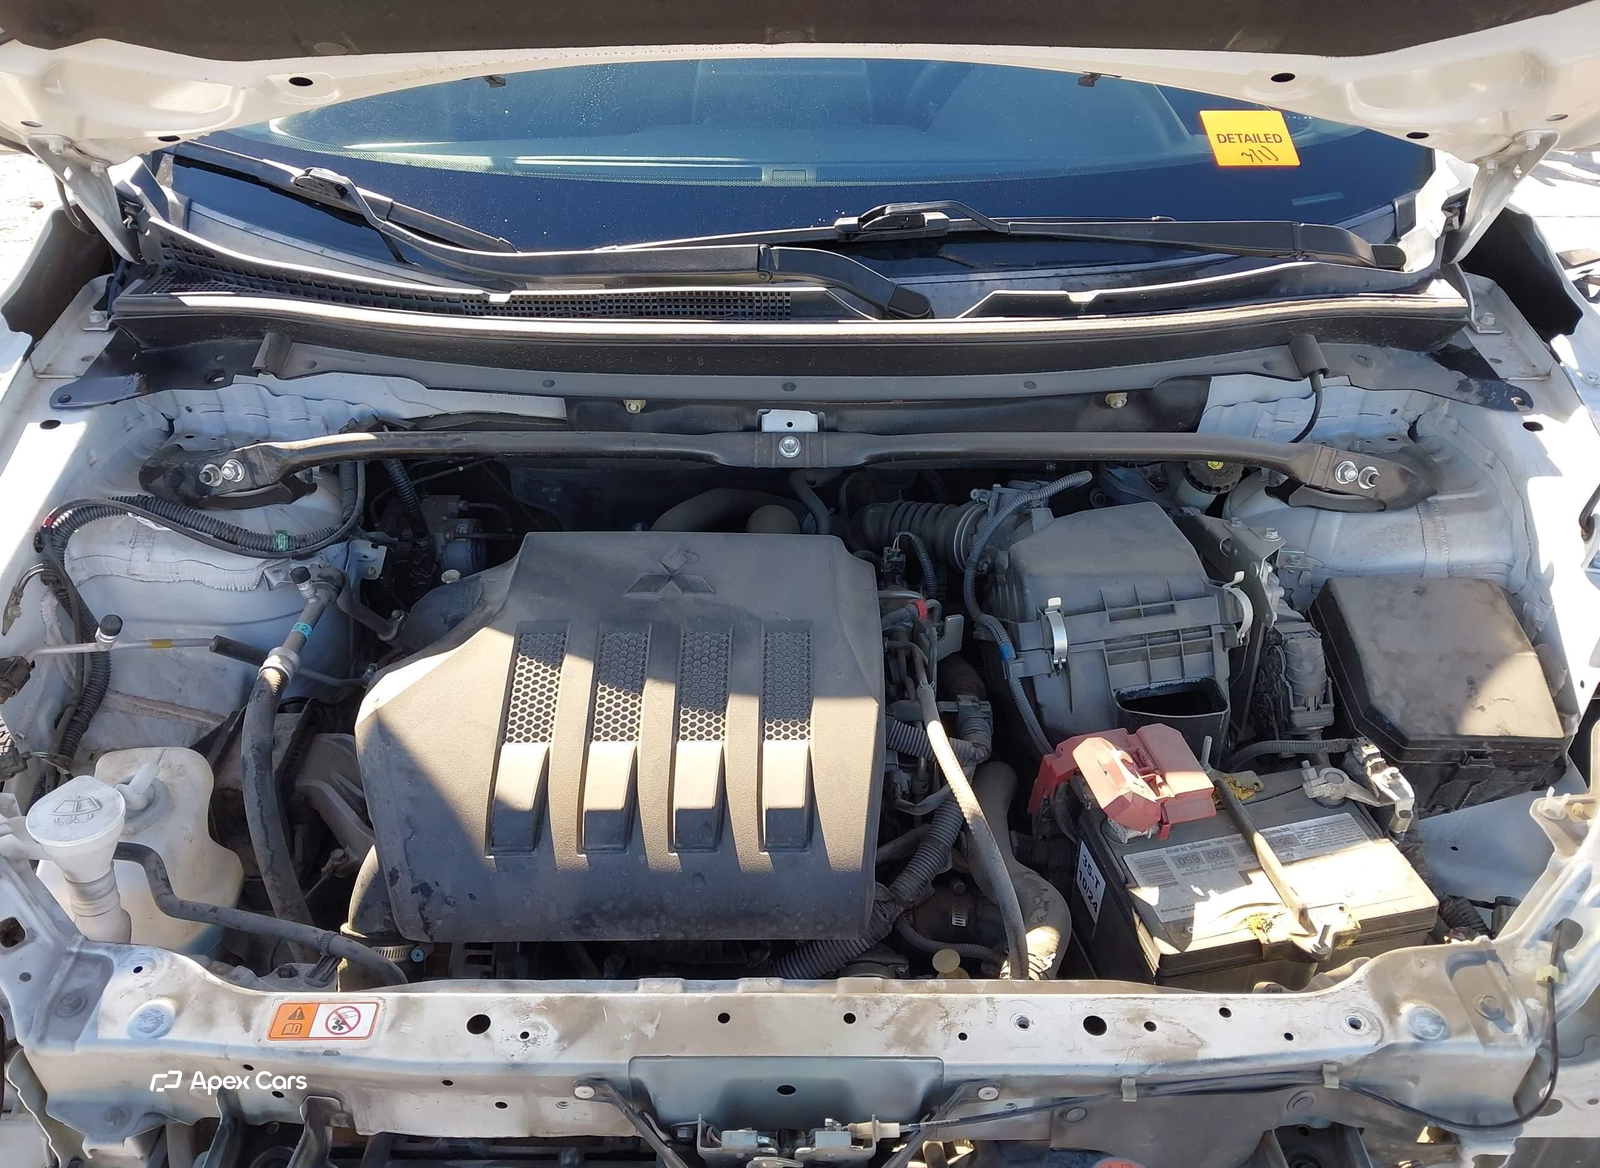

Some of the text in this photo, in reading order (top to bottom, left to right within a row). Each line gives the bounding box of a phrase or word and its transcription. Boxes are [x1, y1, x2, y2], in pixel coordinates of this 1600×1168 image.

[1216, 133, 1283, 144] DETAILED
[1178, 854, 1201, 867] 650
[1207, 848, 1230, 861] 520
[1082, 855, 1101, 890] 35-T
[1079, 869, 1098, 913] 10/24
